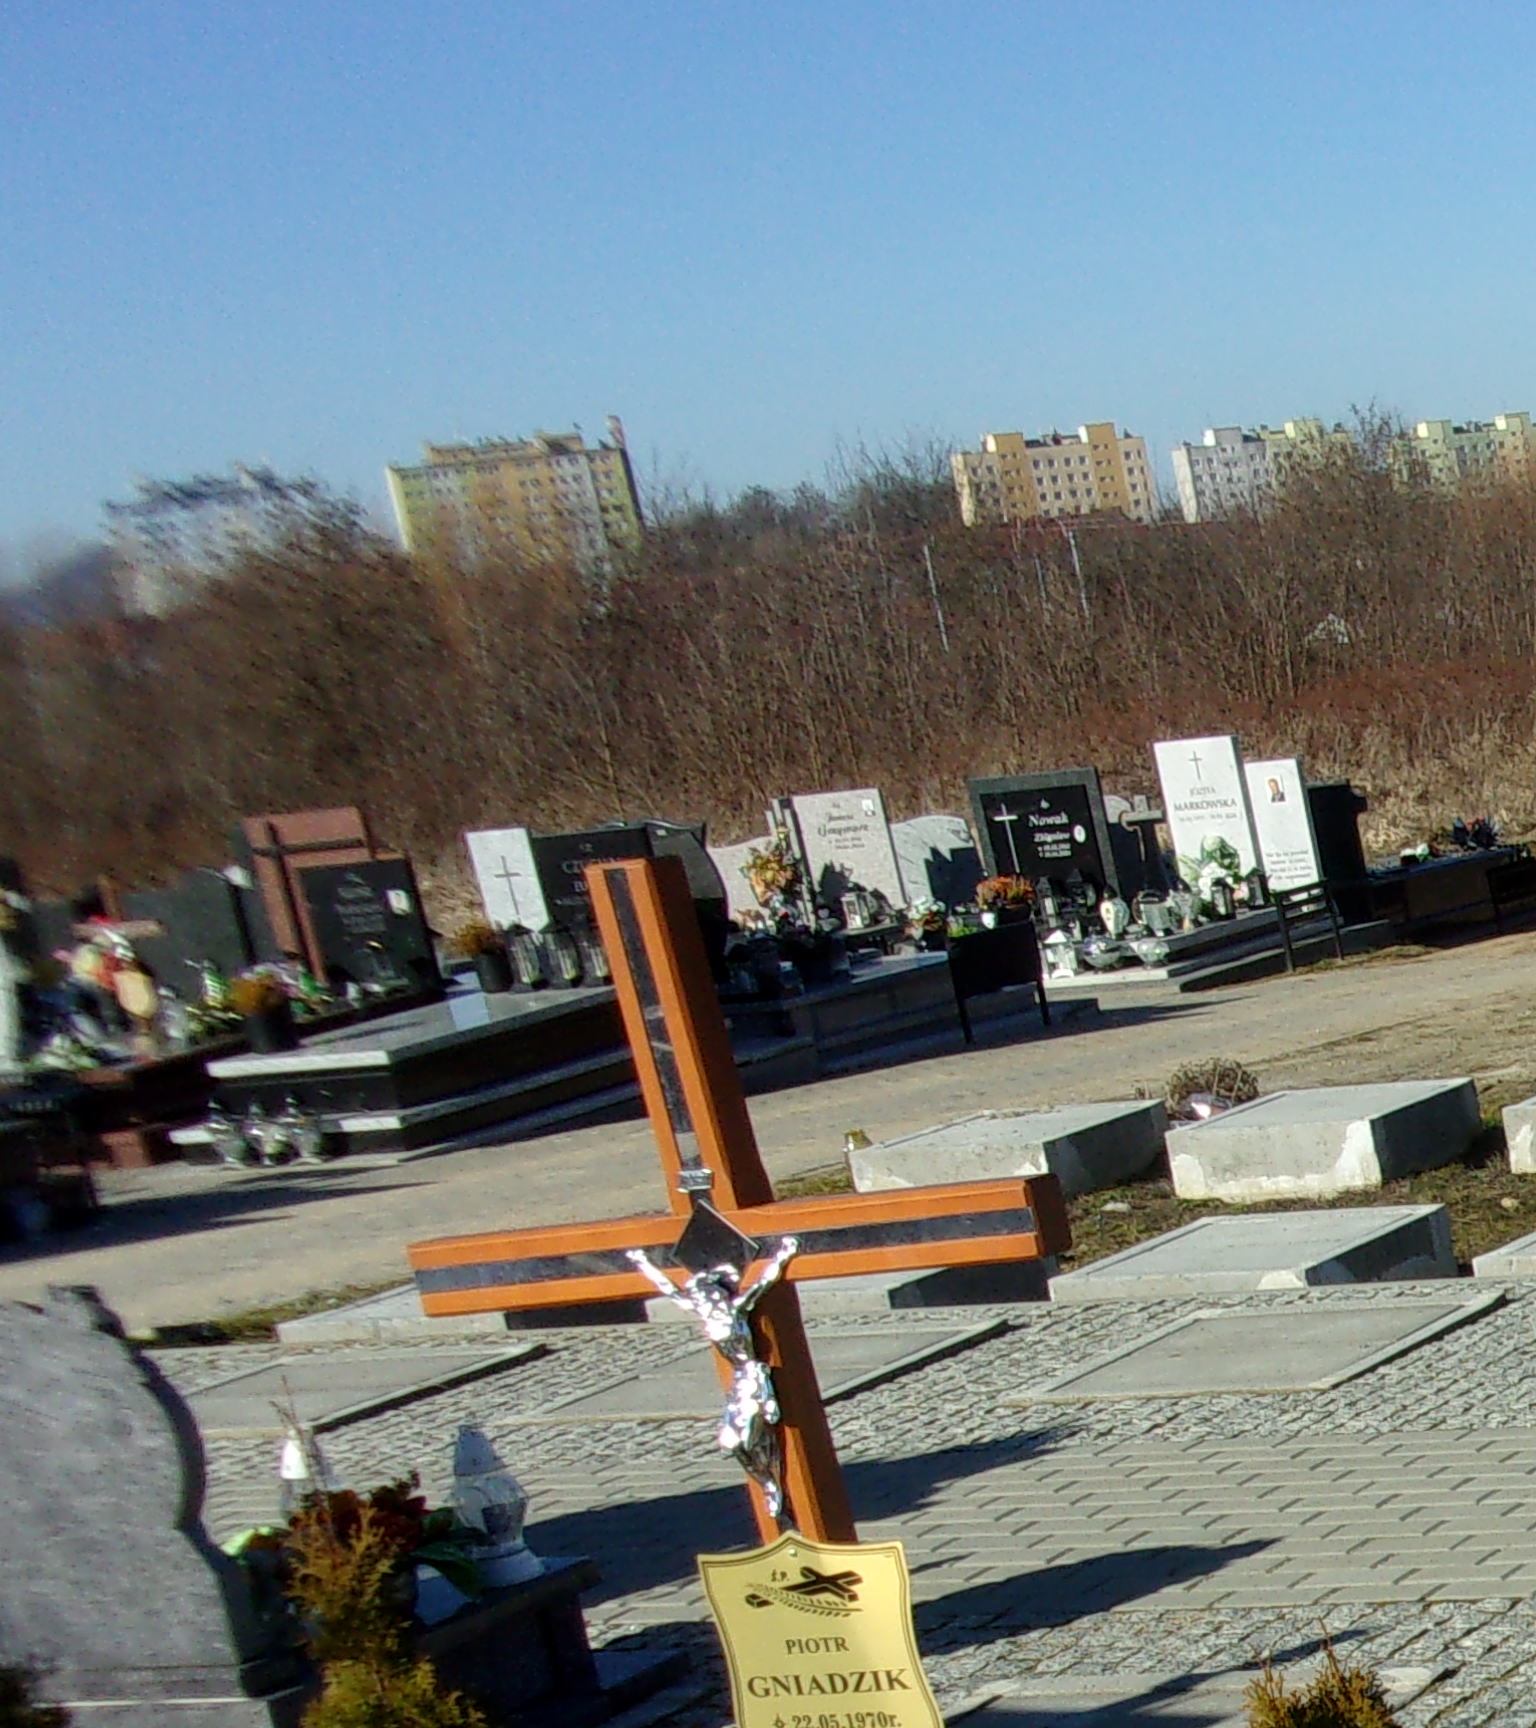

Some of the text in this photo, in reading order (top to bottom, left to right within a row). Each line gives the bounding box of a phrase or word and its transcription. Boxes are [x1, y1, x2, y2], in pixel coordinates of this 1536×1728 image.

[1174, 798, 1237, 811] MARKOWSKA
[1028, 811, 1069, 827] Nowak
[785, 1636, 850, 1655] PIOTR
[747, 1668, 913, 1699] GNIADZIK
